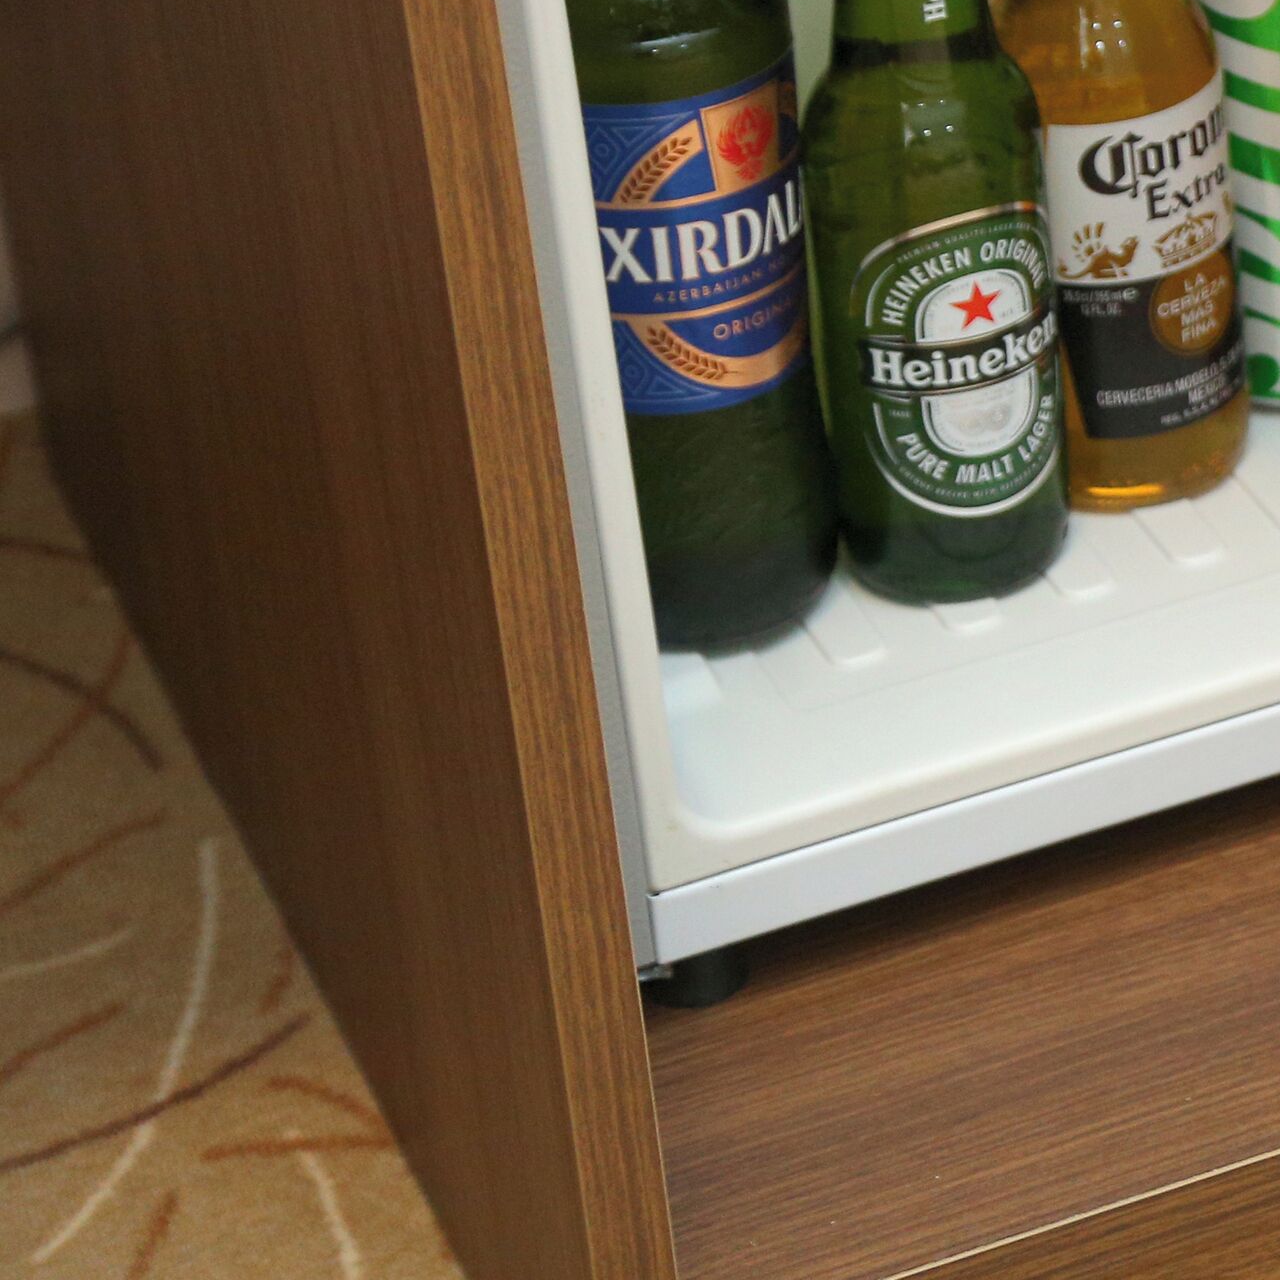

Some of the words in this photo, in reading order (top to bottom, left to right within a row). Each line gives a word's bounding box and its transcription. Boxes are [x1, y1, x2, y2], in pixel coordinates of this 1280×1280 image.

[1081, 105, 1224, 198] Coron
[1147, 164, 1226, 221] Extra
[599, 180, 802, 284] XIRDAL
[882, 248, 972, 326] HEINEKEN
[980, 238, 1047, 290] ORIGINAL
[1157, 275, 1228, 318] CERVEZA
[1184, 274, 1206, 293] LA
[1181, 319, 1218, 344] FINA
[896, 431, 949, 480] PURE
[955, 459, 1015, 485] MALT
[1020, 393, 1054, 462] LAGER
